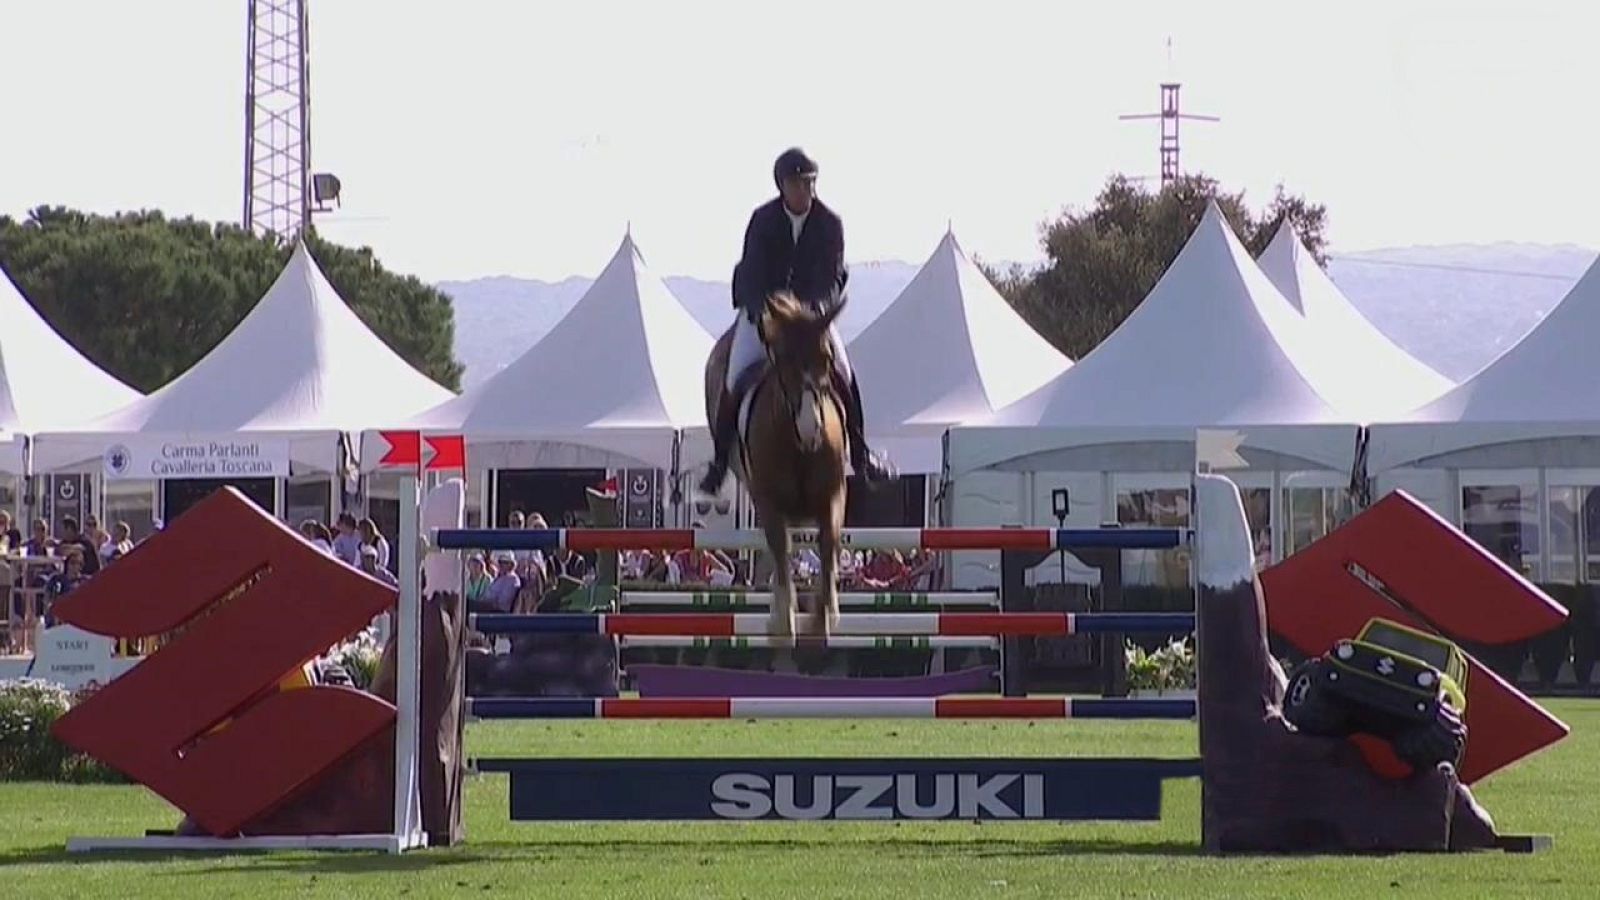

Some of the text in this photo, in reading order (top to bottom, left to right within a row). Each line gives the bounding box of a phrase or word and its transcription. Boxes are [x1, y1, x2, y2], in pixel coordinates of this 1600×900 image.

[161, 440, 260, 459] Carma Parlanti
[151, 458, 273, 475] Cavalleria Toscana
[710, 773, 1045, 820] SUZUKI
